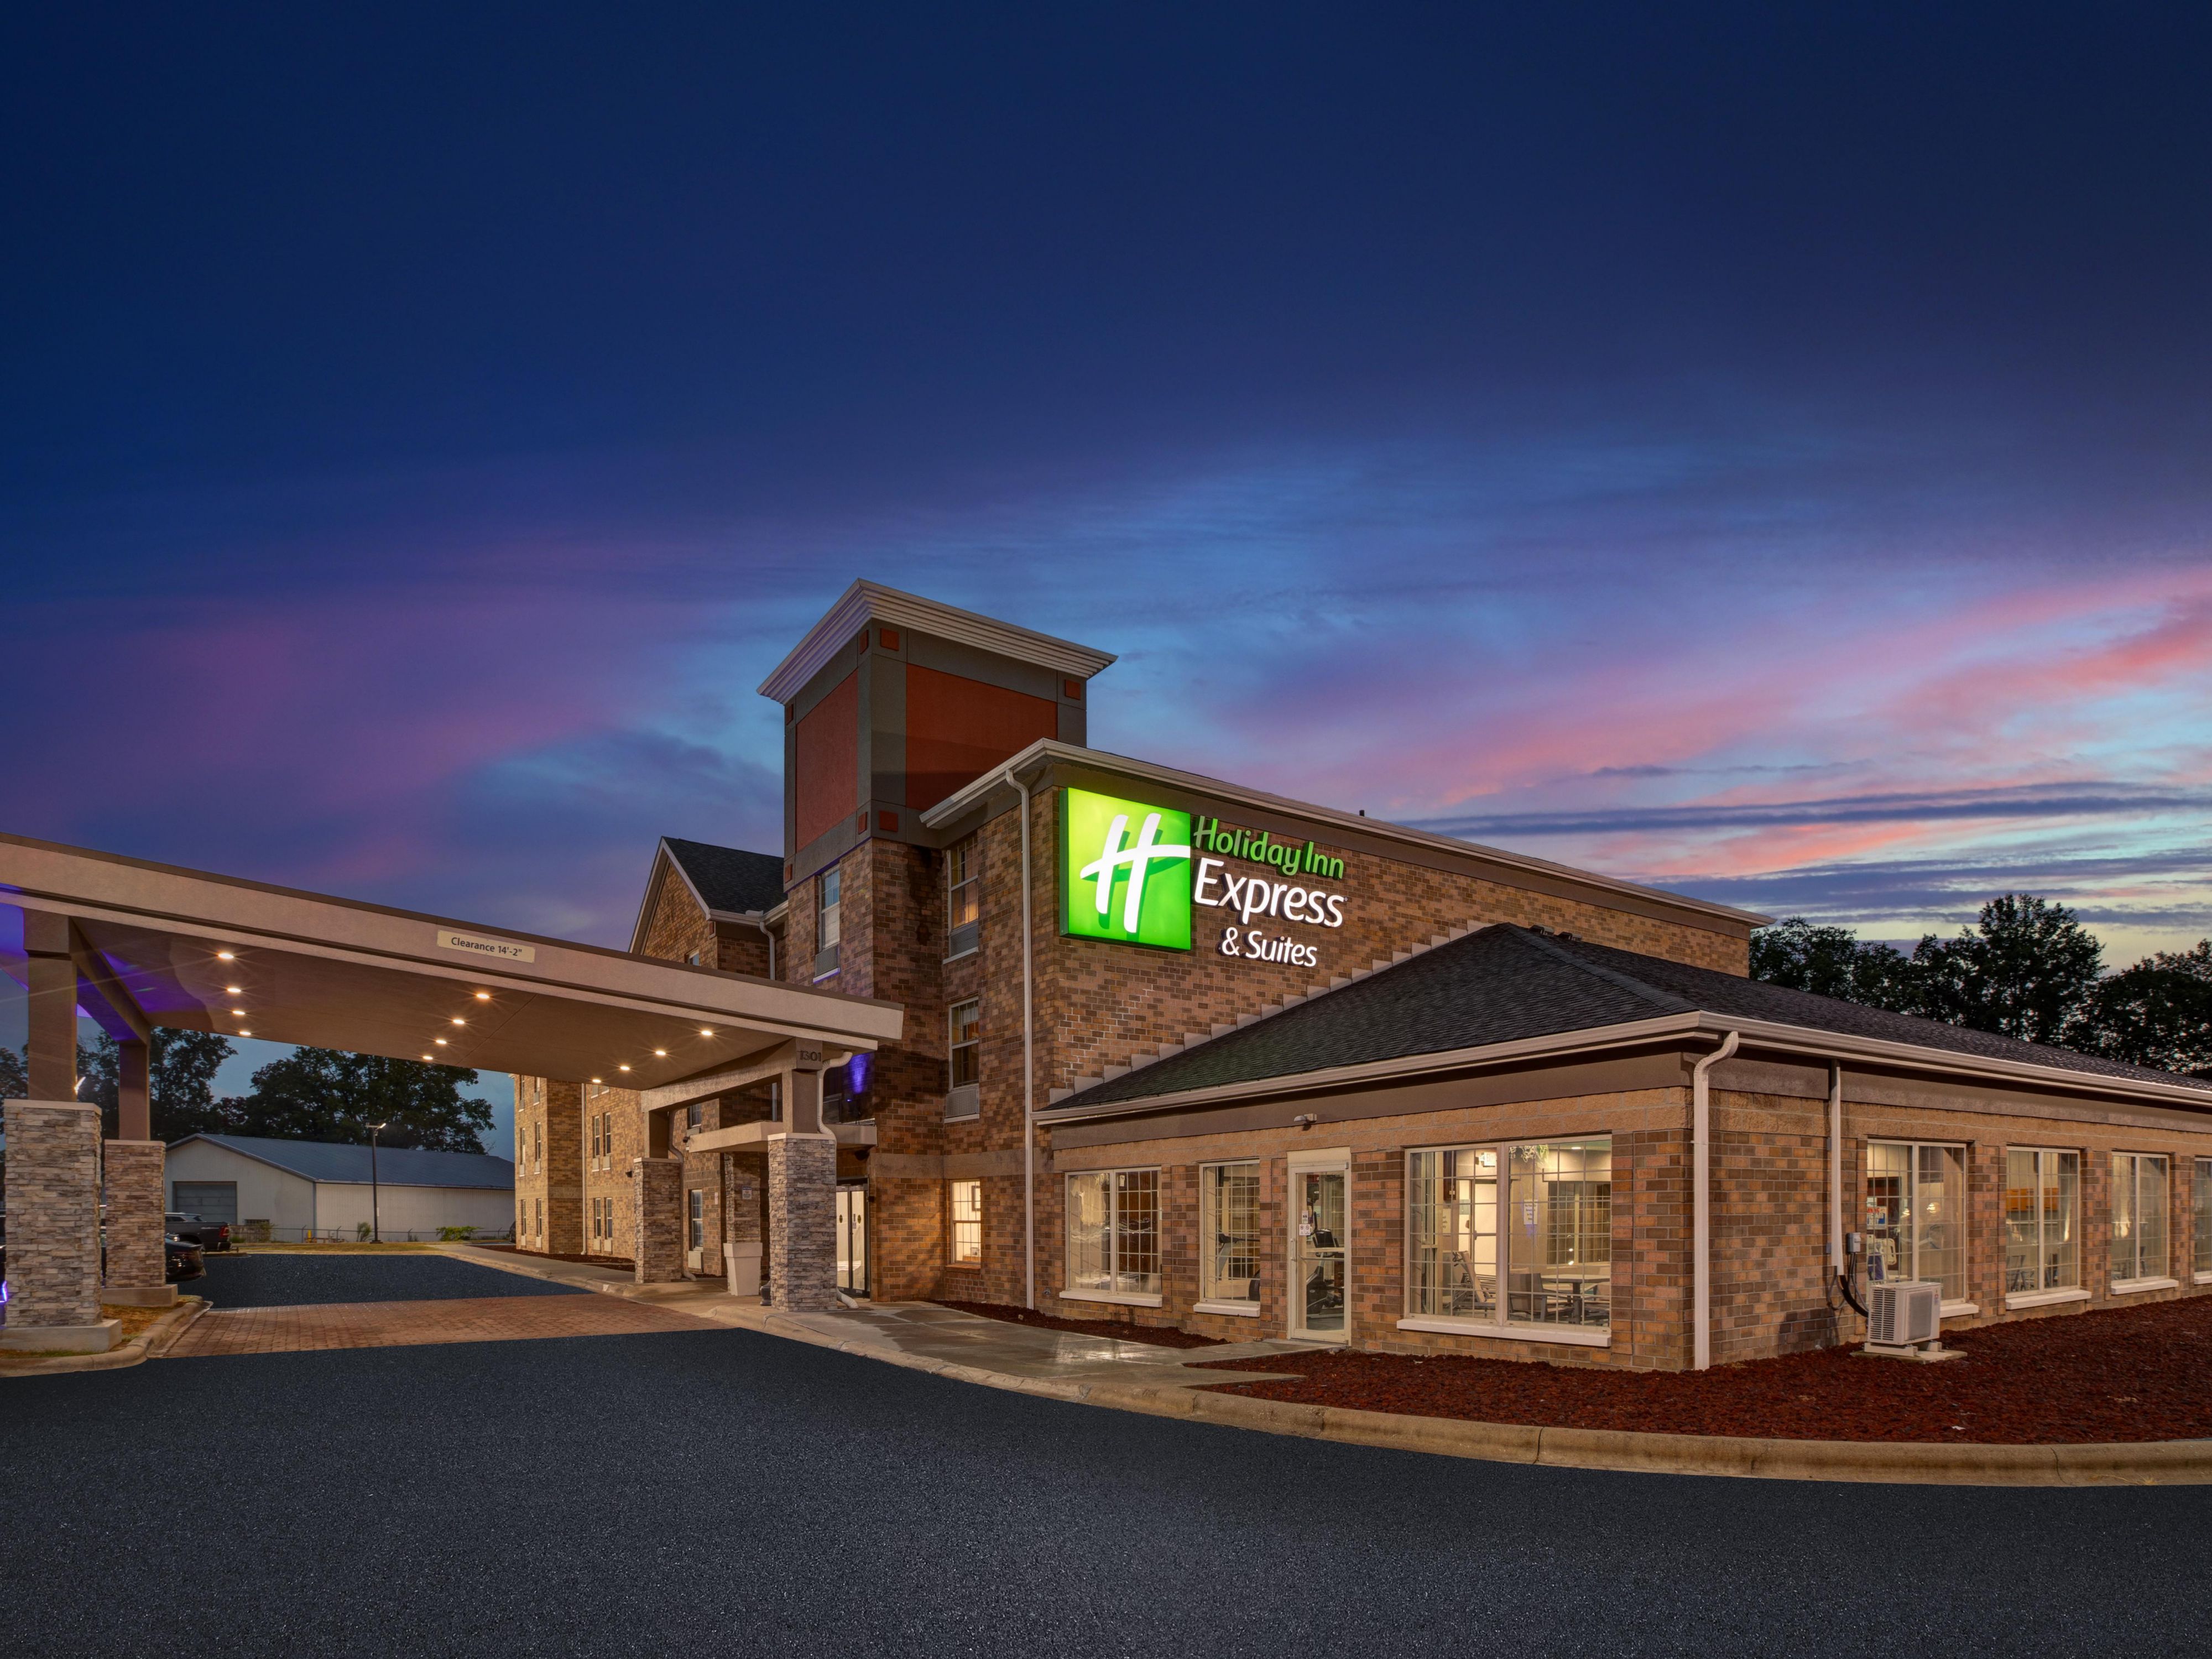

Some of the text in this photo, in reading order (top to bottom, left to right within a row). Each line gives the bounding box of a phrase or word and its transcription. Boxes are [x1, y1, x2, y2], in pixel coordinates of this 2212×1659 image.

[1193, 815, 1344, 879] Holiday Inn
[1194, 857, 1344, 927] Express
[451, 937, 522, 956] Clearance 14'-2"
[1222, 927, 1318, 967] & Suites
